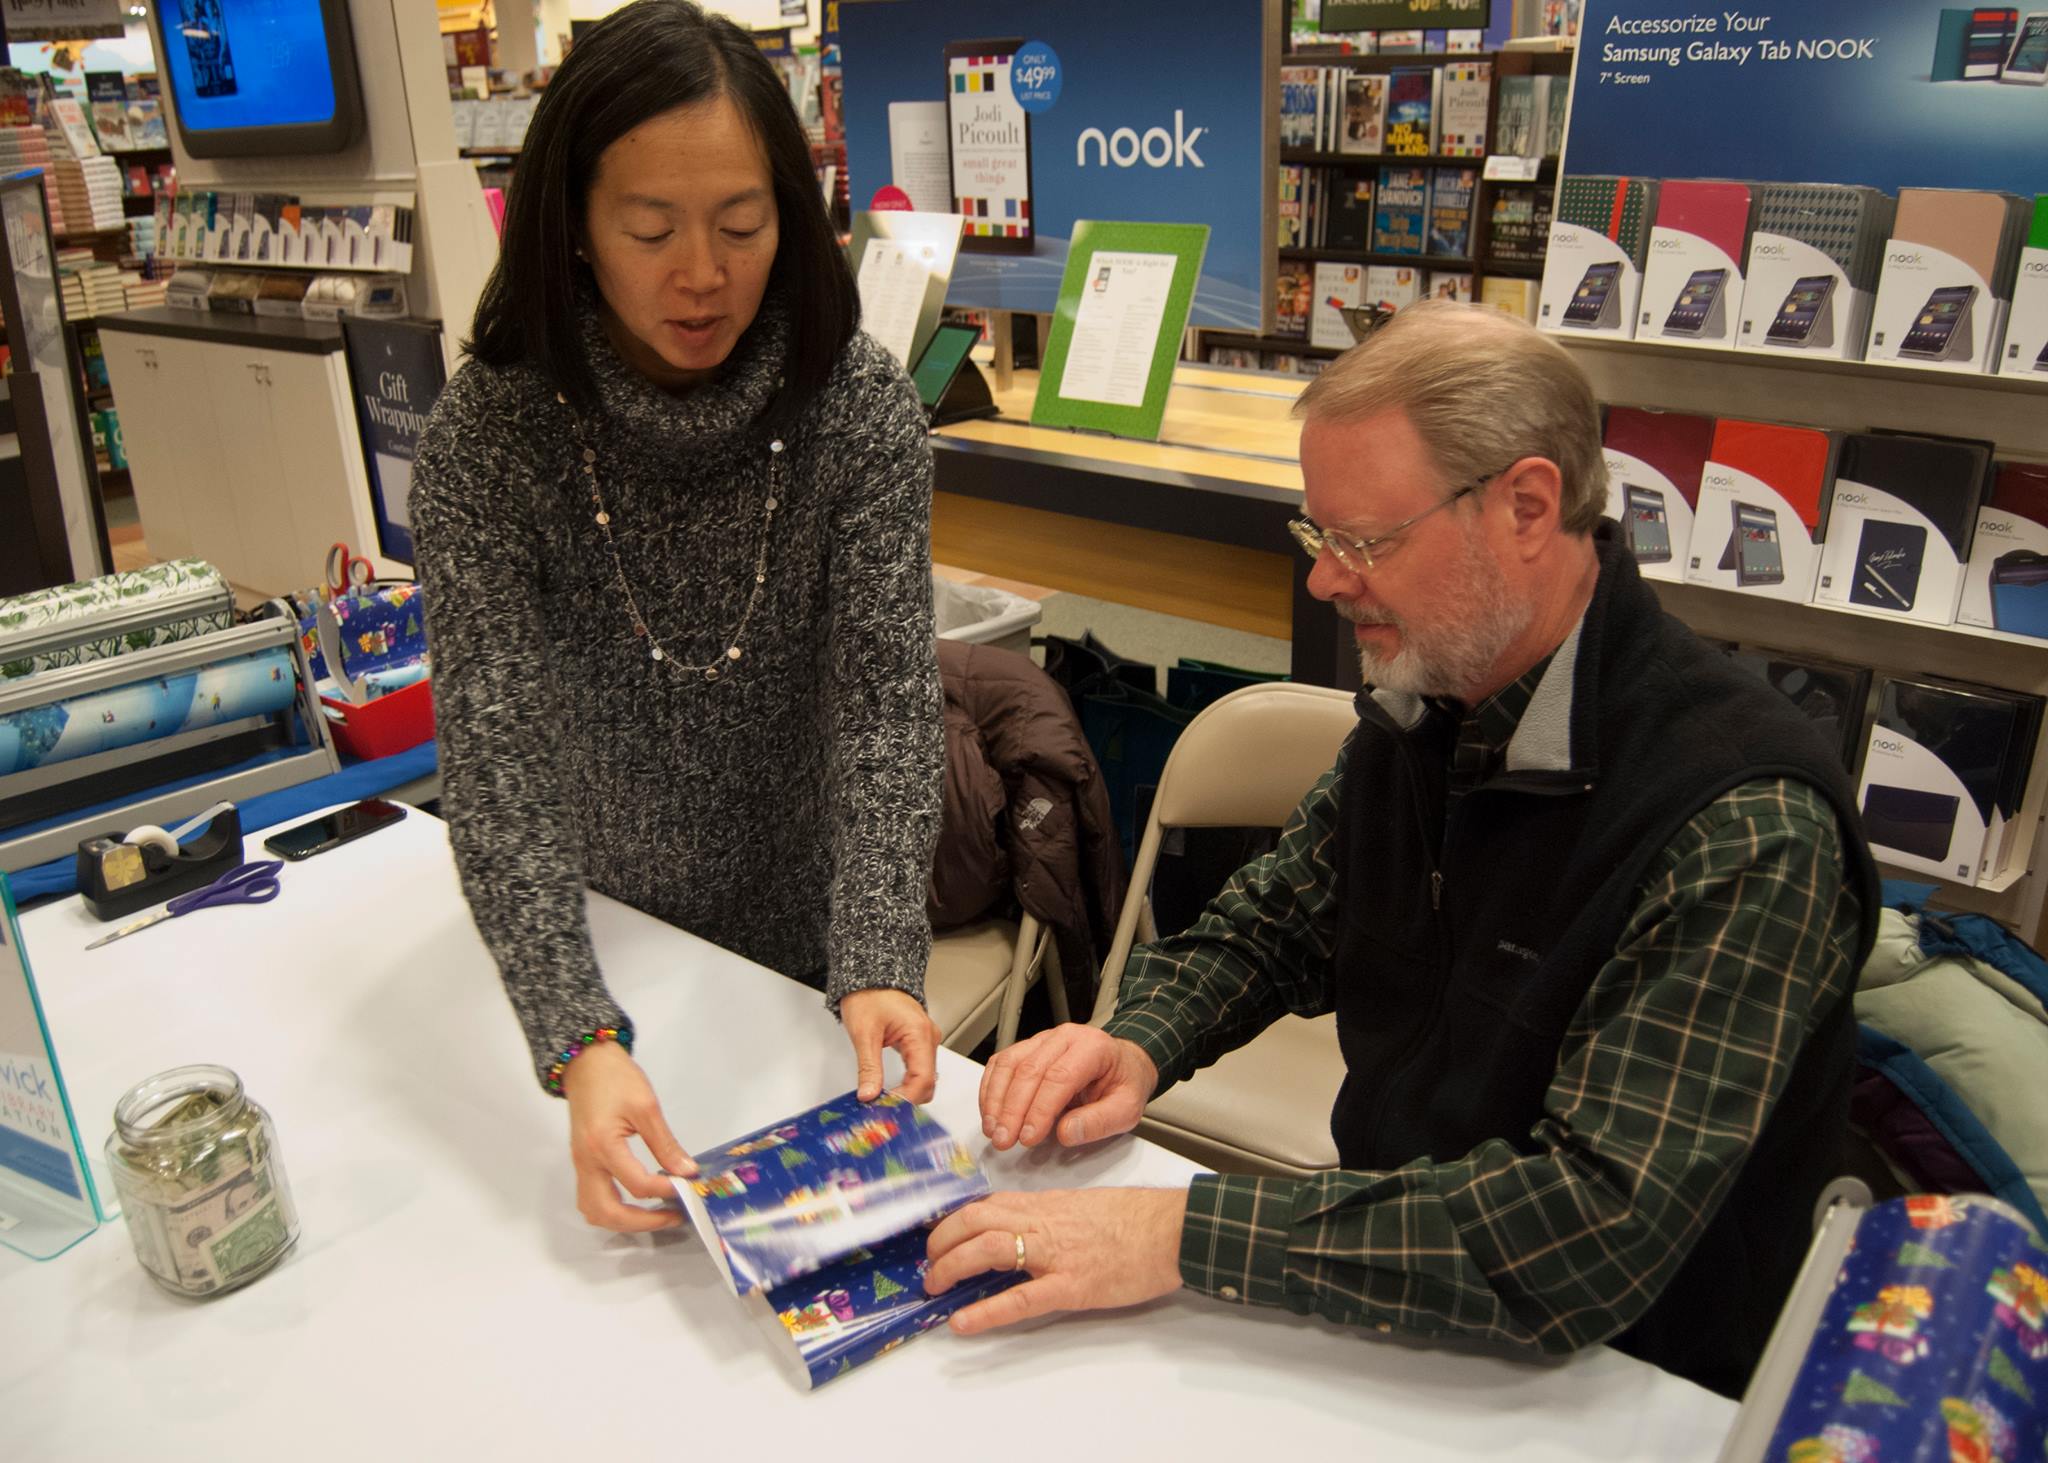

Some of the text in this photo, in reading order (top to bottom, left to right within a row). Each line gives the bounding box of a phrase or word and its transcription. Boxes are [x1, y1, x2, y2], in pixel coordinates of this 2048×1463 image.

[1605, 11, 1771, 35] Accessorize Your
[1602, 38, 1876, 66] Samsung Galaxy Tab NOOK
[1023, 55, 1046, 65] ONLY
[1614, 72, 1650, 84] Screen
[973, 104, 1002, 122] Jodi
[959, 122, 1019, 145] Picoult
[1077, 109, 1205, 168] nook
[1396, 144, 1429, 157] LAND
[962, 157, 1017, 171] small great
[975, 172, 1006, 186] things
[1553, 232, 1578, 243] nook
[1654, 238, 1681, 249] nook
[1755, 243, 1785, 255] nook
[1889, 252, 1923, 264] nook
[379, 371, 408, 402] Gift
[365, 395, 425, 436] Wrappin
[1705, 475, 1736, 486] nook
[1837, 493, 1869, 504] nook
[1979, 521, 2014, 533] nook
[1873, 739, 1904, 752] nook
